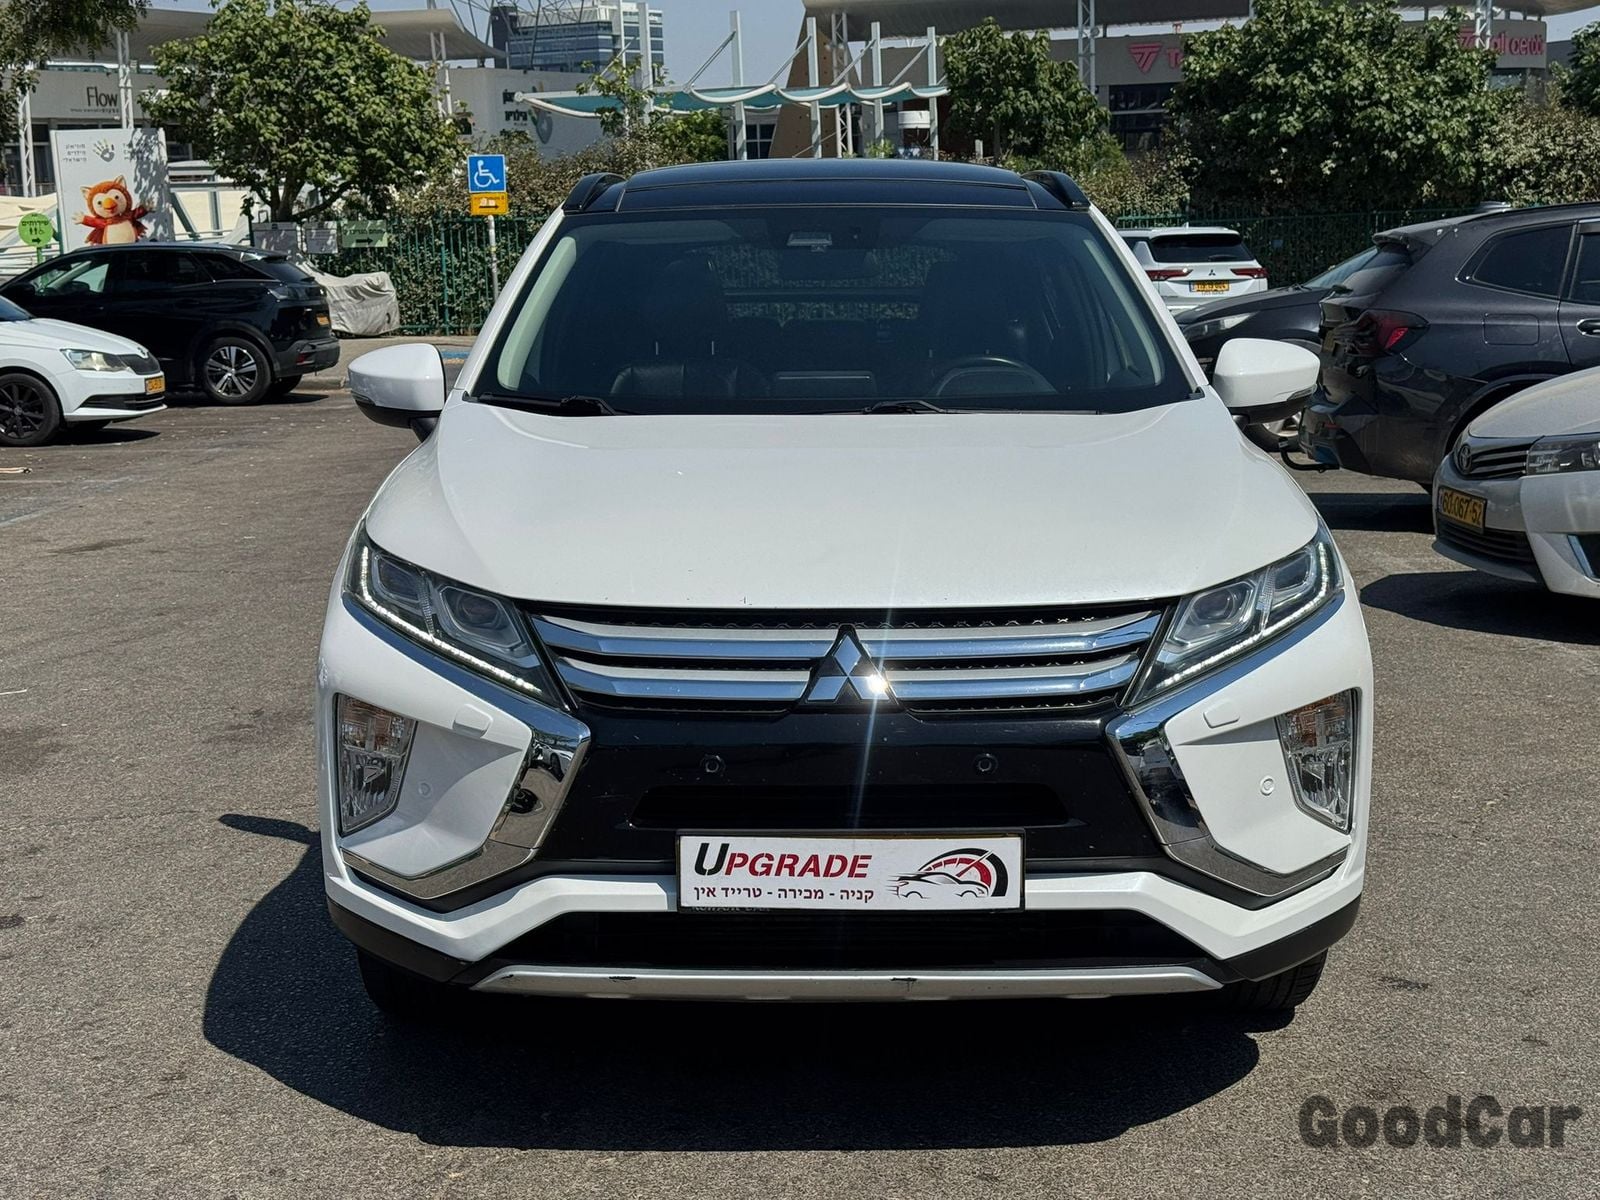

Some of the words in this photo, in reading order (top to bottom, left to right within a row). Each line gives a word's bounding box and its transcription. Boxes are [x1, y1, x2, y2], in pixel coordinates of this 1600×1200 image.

[86, 86, 118, 107] Flow
[693, 886, 717, 901] אין
[720, 887, 762, 899] טרייד
[777, 888, 824, 900] מכירה
[839, 889, 874, 904] קניה
